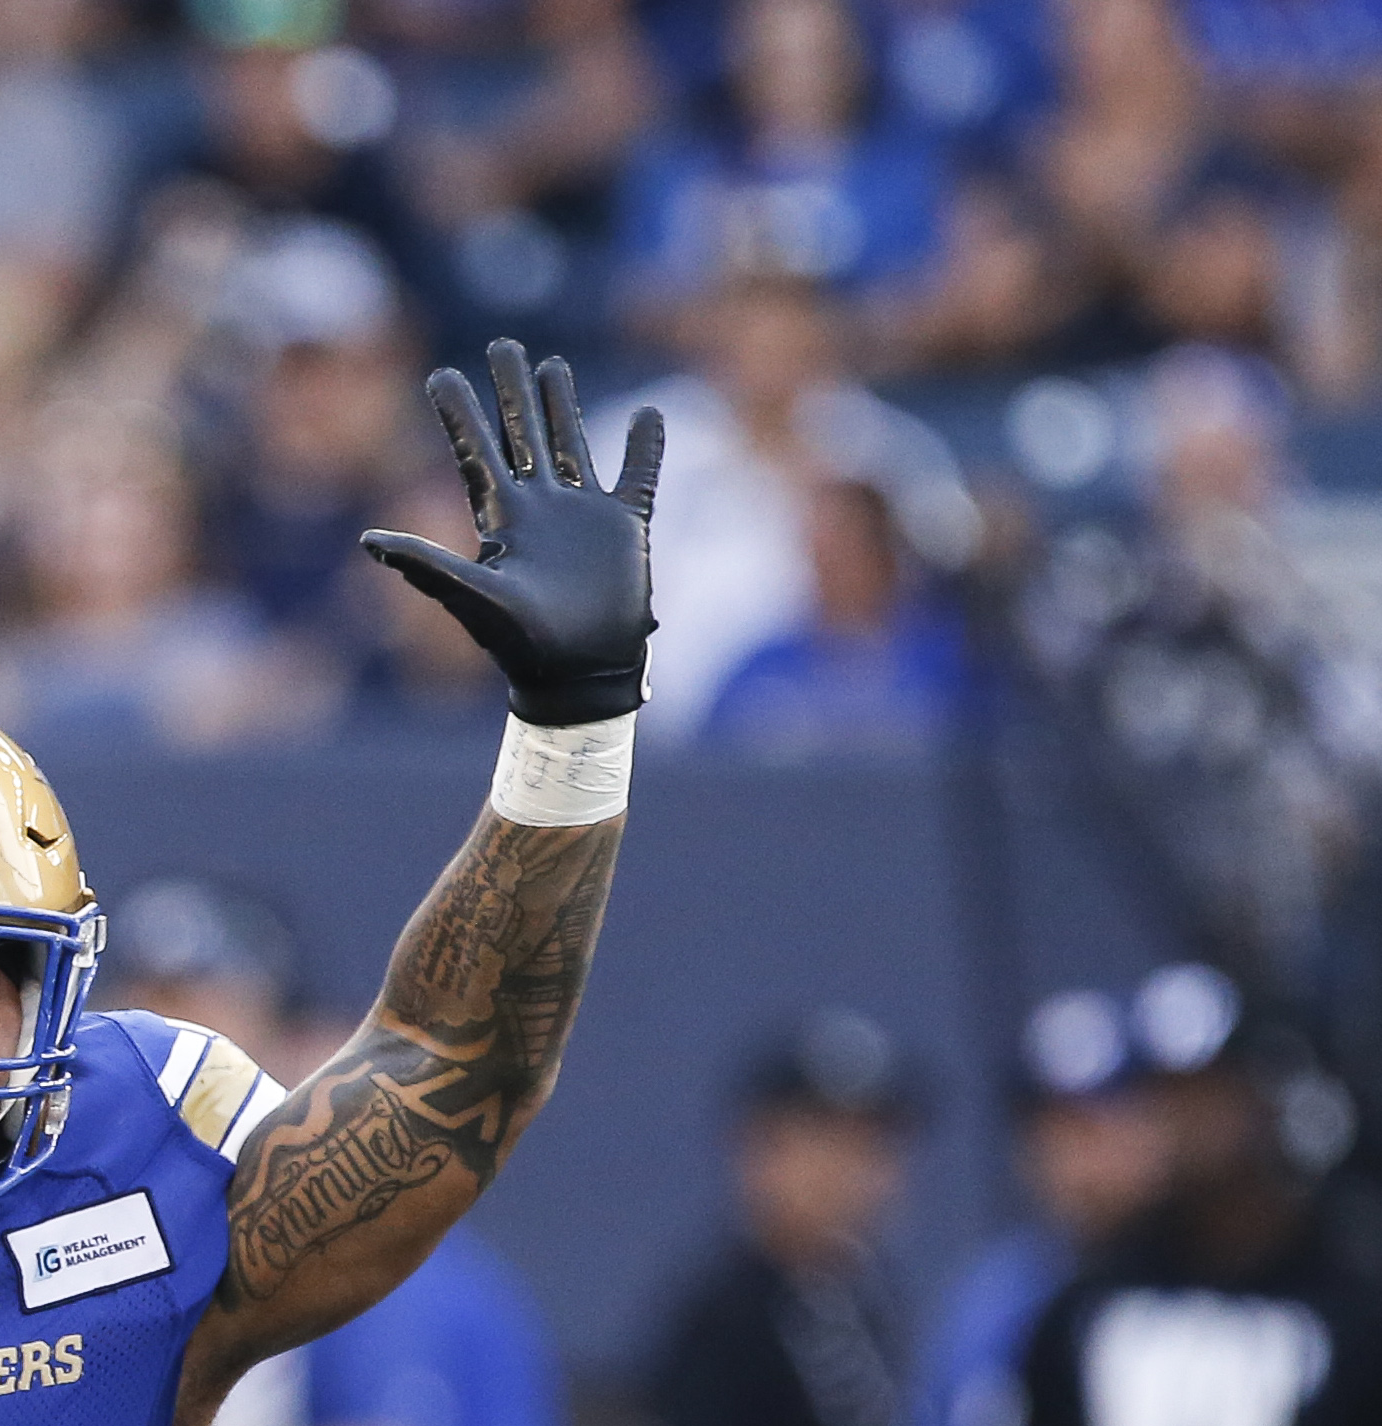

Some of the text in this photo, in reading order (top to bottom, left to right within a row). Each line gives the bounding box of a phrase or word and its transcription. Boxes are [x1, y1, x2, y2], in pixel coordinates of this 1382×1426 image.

[228, 1090, 428, 1300] Committed
[63, 1233, 109, 1255] WEALTH
[65, 1235, 147, 1267] MANAGEMENT
[35, 1248, 62, 1277] IG
